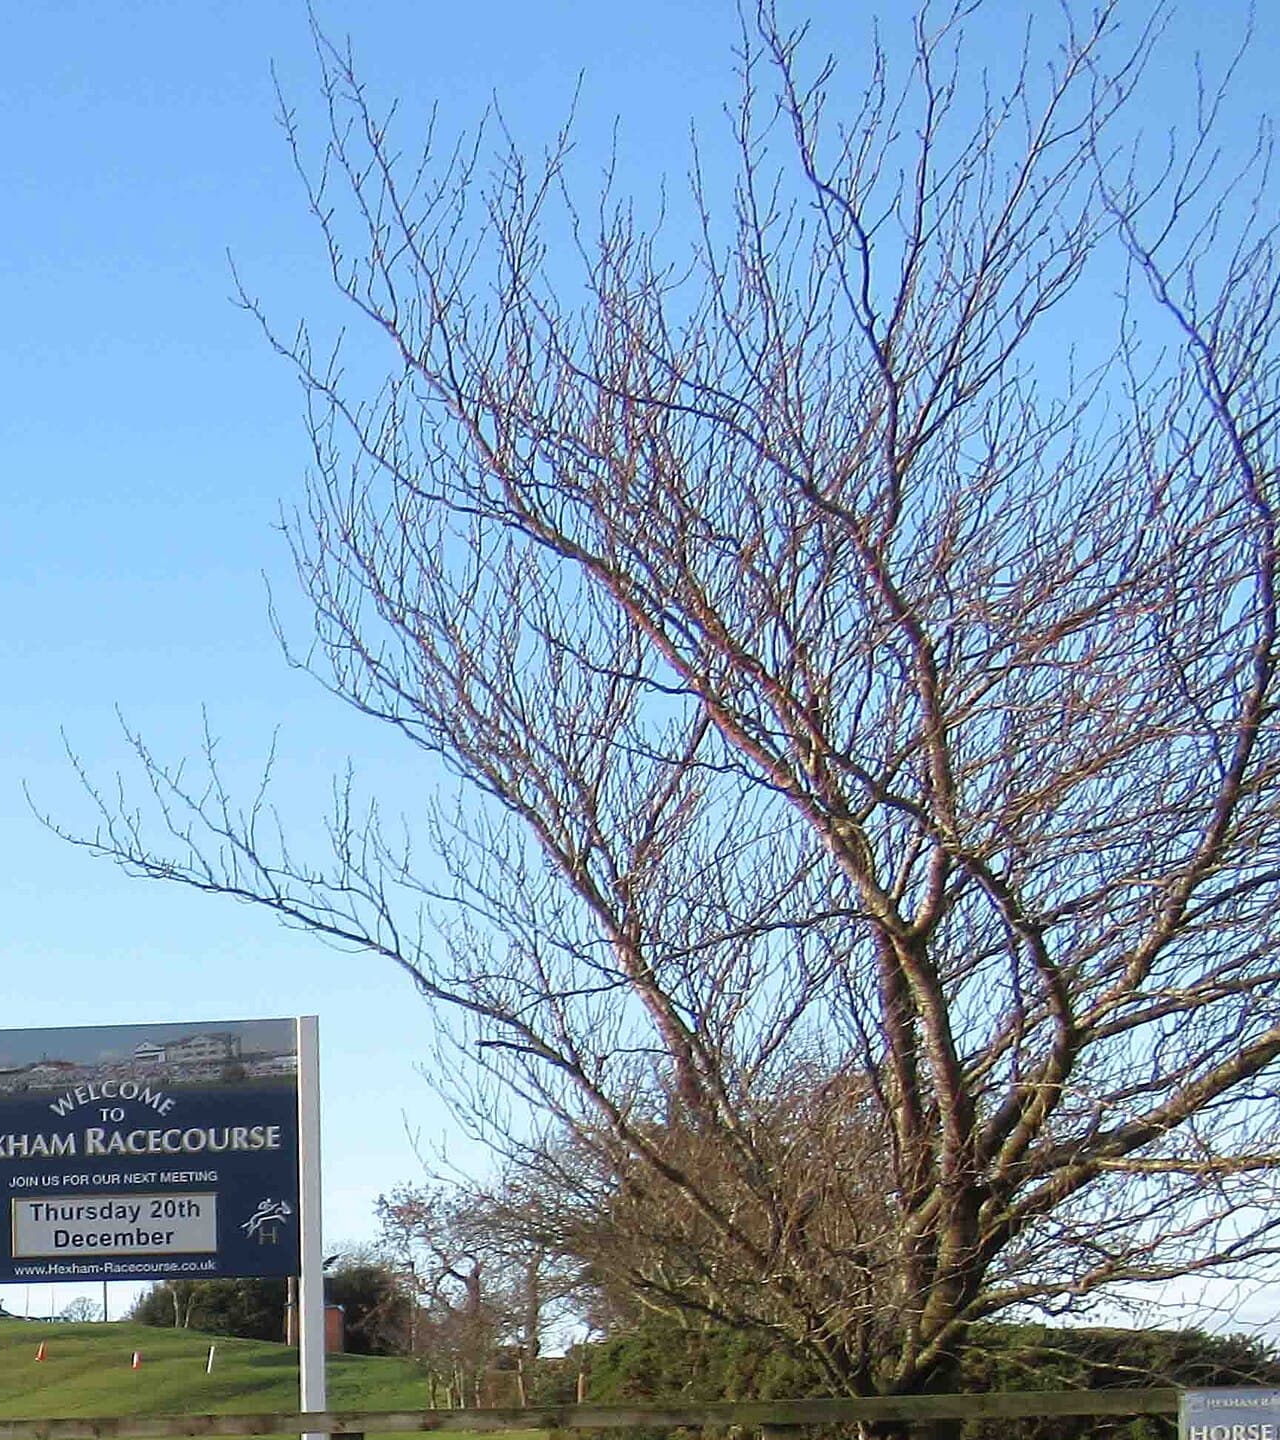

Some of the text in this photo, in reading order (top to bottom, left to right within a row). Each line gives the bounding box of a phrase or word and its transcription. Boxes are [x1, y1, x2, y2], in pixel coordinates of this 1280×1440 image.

[48, 1079, 177, 1118] WELCOME
[99, 1107, 125, 1123] TO
[85, 1125, 282, 1156] RACECOURSE
[8, 1170, 218, 1188] JOIN US FOR OUR NEXT MEETING
[29, 1199, 201, 1224] Thursday 20th
[53, 1227, 174, 1248] December
[13, 1258, 217, 1276] www.Hexham-Racecourse.co.uk
